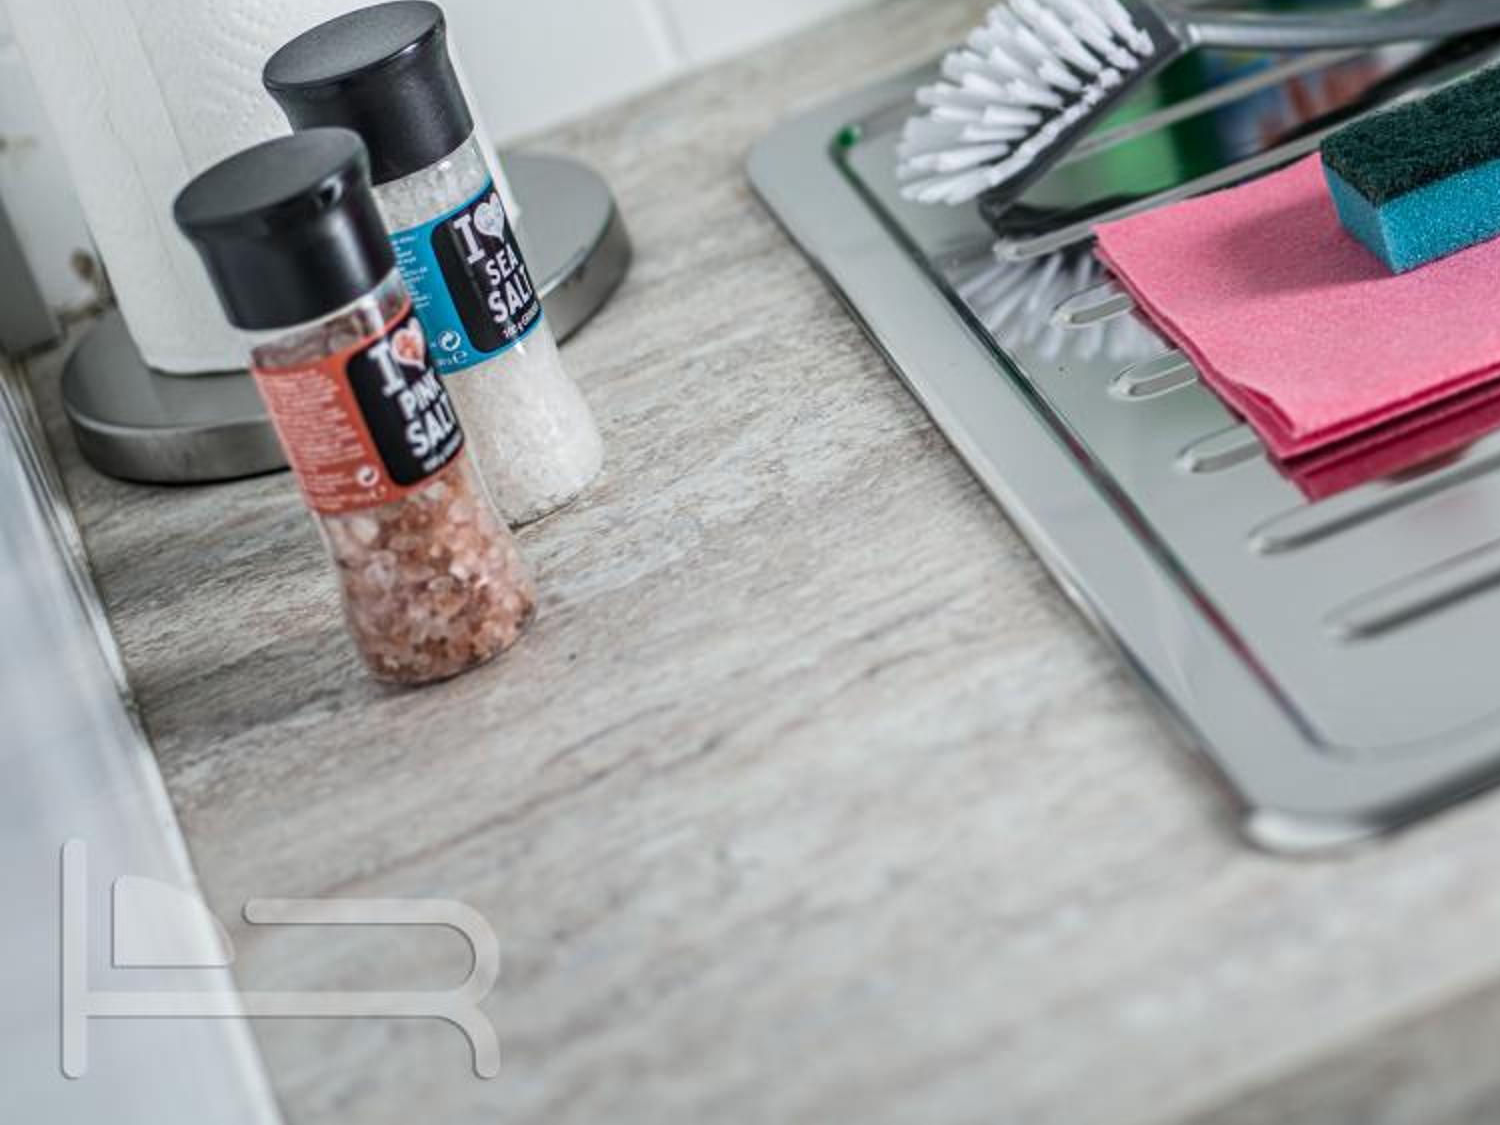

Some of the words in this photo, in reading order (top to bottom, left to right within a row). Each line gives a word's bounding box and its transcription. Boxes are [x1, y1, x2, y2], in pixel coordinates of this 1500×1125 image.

[453, 214, 485, 264] I
[485, 243, 519, 286] SEA
[488, 265, 533, 323] SALT
[367, 339, 406, 397] I
[406, 394, 457, 457] SALT
